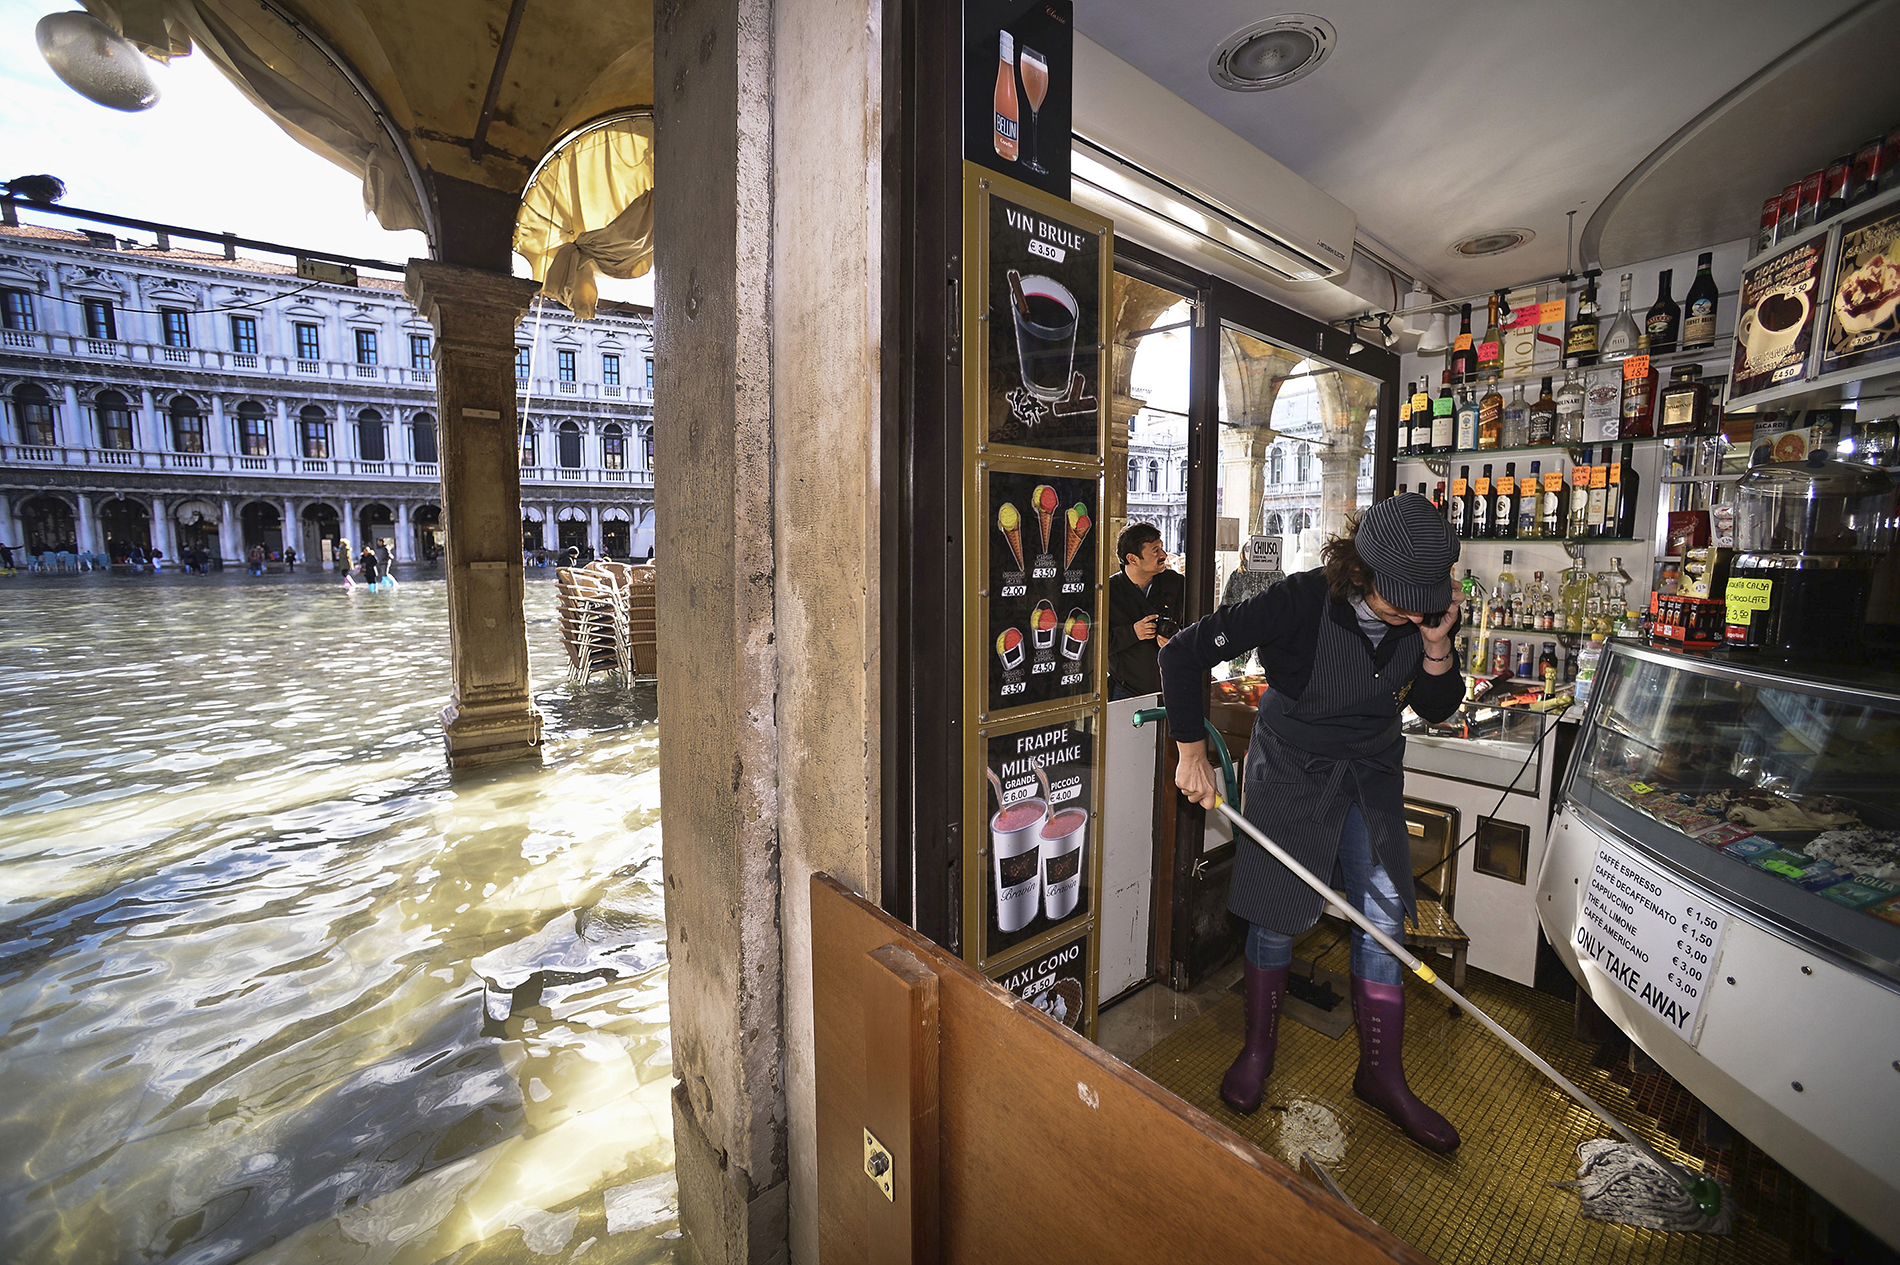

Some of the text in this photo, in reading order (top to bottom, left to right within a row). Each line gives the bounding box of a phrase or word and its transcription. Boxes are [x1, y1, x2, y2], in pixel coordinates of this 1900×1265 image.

[1006, 207, 1033, 233] VIN
[1754, 245, 1811, 280] CIOCCOLATA
[1747, 275, 1773, 294] CALDA
[1017, 728, 1068, 754] FRAPPE
[1002, 745, 1081, 779] MILKSHAKE
[1005, 774, 1036, 790] GRANDE
[1050, 776, 1080, 791] PICCOLO
[1620, 865, 1662, 897] ESPRESSO
[1695, 914, 1718, 931] 1,50
[1854, 875, 1895, 891] GOLIA
[1591, 878, 1634, 915] CAPPUCCINO
[1684, 946, 1708, 965] 3,00
[1615, 879, 1677, 926] DECAFFEINATO
[1691, 930, 1713, 948] 1,50
[1588, 891, 1600, 908] THE
[1599, 902, 1608, 915] AL
[1608, 909, 1638, 937] LIMONE
[1680, 961, 1703, 982] 3,00
[1038, 945, 1080, 975] CONO
[1602, 923, 1649, 963] AMERICANO
[1675, 977, 1698, 999] 3,00
[1577, 926, 1691, 1030] ONLY TAKE AWAY
